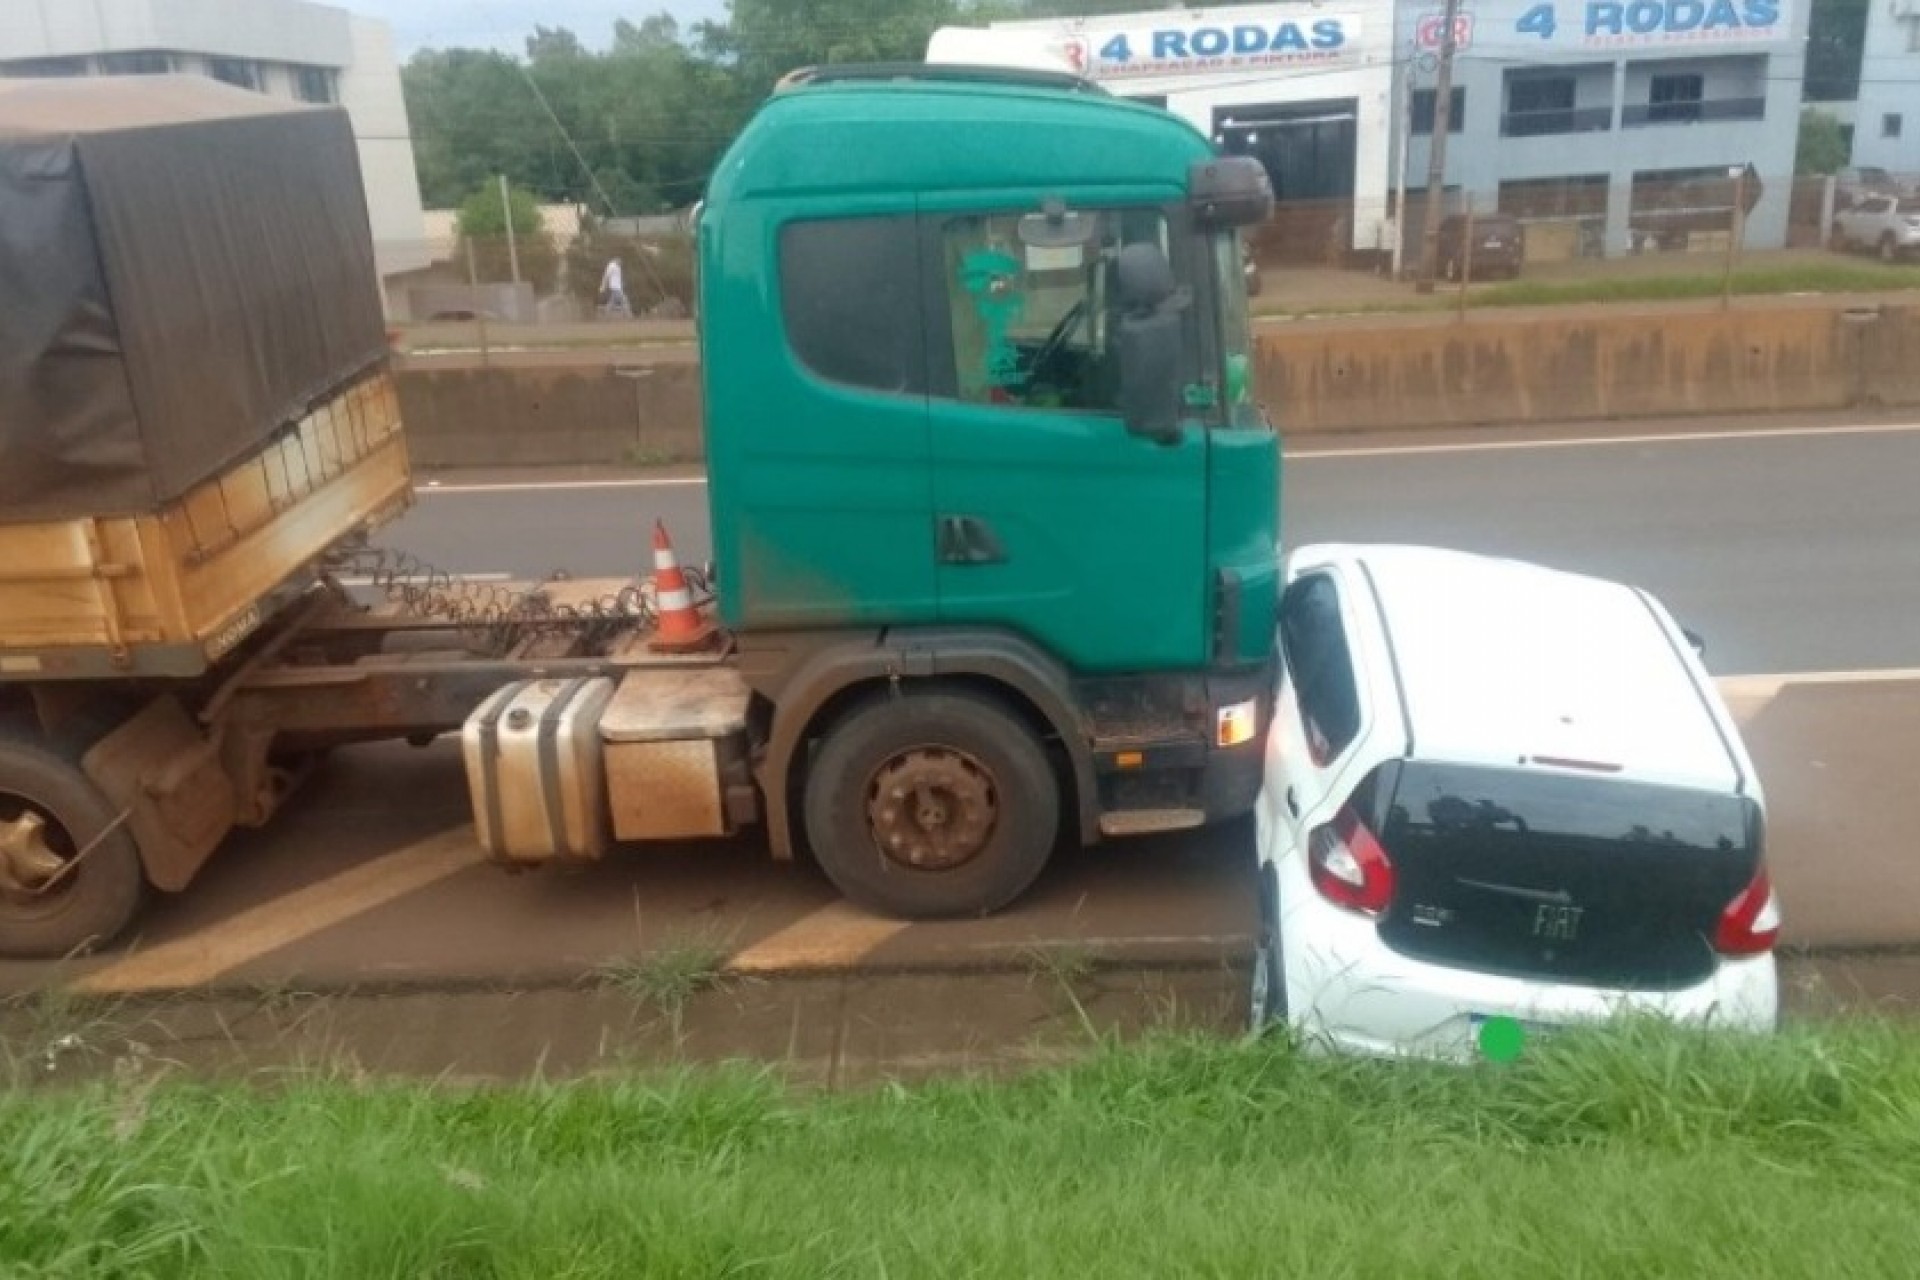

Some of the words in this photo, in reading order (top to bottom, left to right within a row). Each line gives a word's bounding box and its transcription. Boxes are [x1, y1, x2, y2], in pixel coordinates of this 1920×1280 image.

[1515, 3, 1557, 40] 4
[1585, 0, 1779, 36] RODAS
[1099, 33, 1132, 63] 4
[1152, 18, 1345, 58] RODAS
[1532, 903, 1584, 939] FIAT
